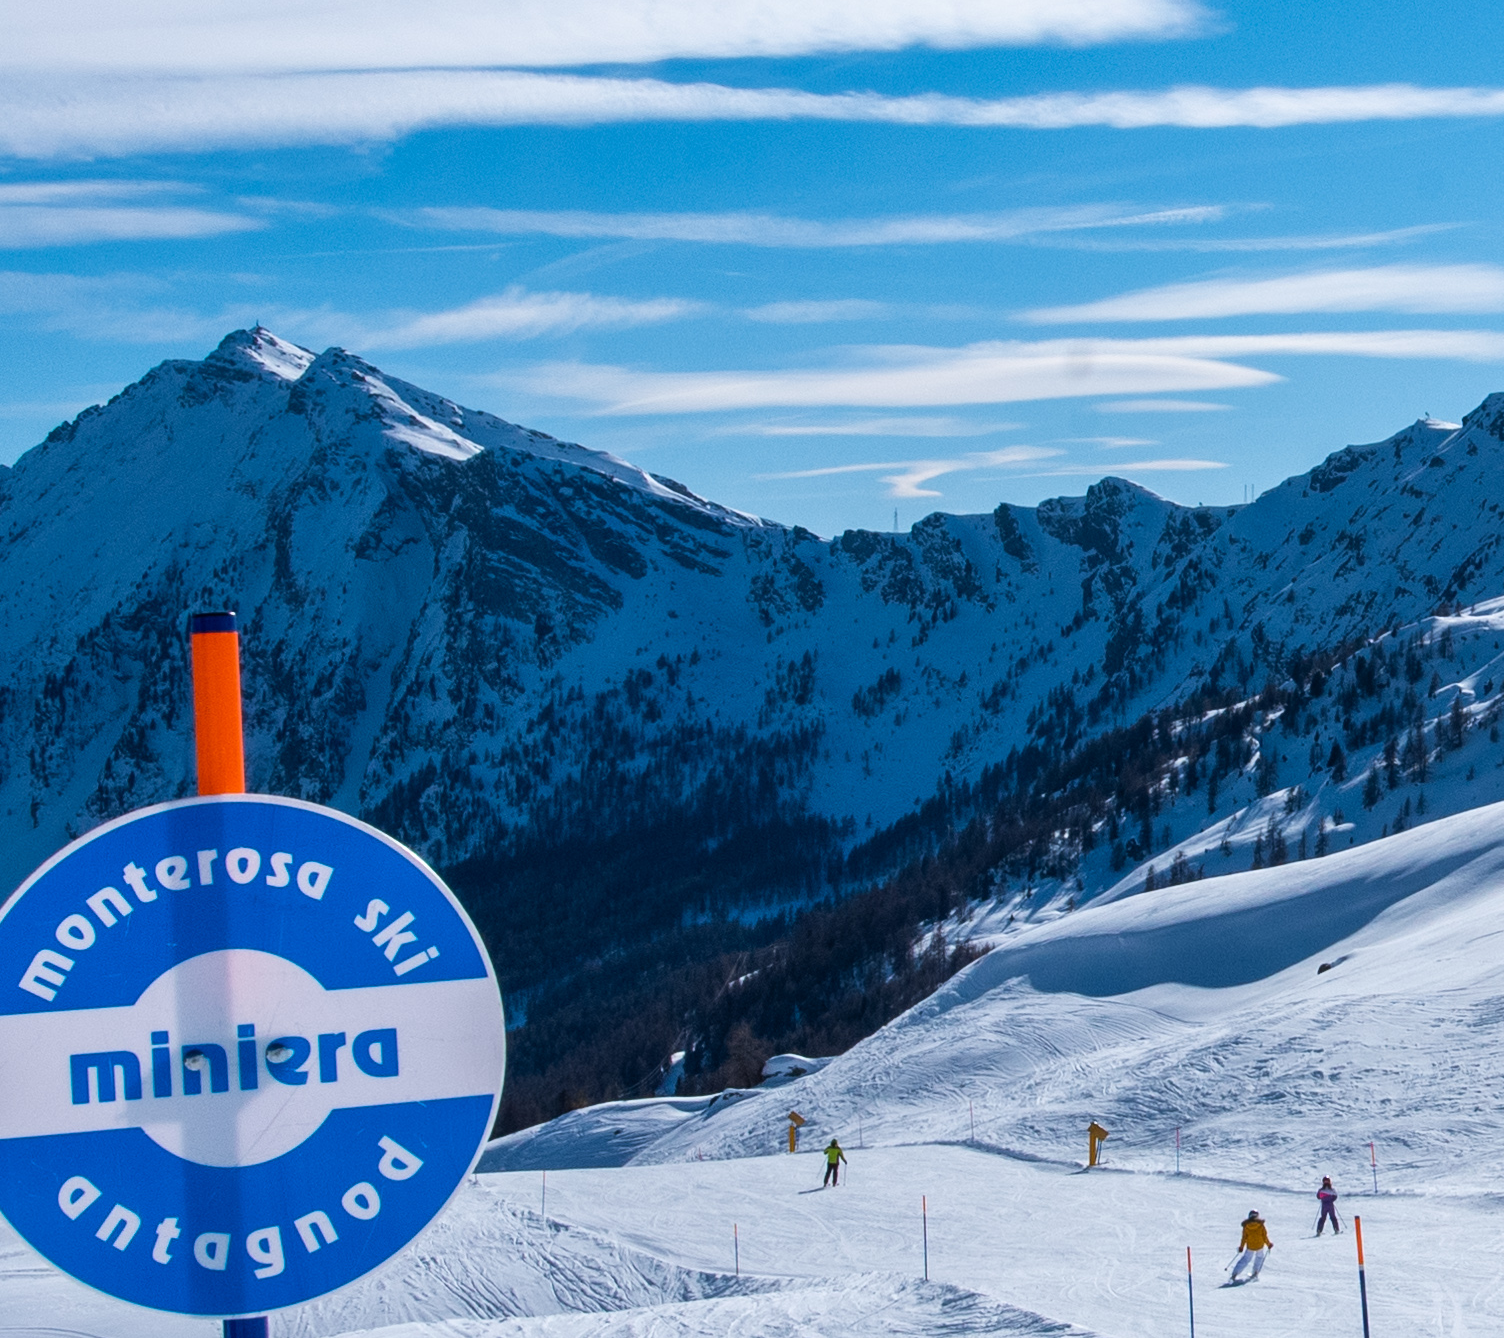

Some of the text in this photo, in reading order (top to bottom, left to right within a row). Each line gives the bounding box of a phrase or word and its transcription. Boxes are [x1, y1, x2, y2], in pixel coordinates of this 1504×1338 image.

[18, 846, 440, 1002] monterosa ski
[69, 1023, 399, 1106] miniera
[57, 1135, 424, 1280] antagnod
